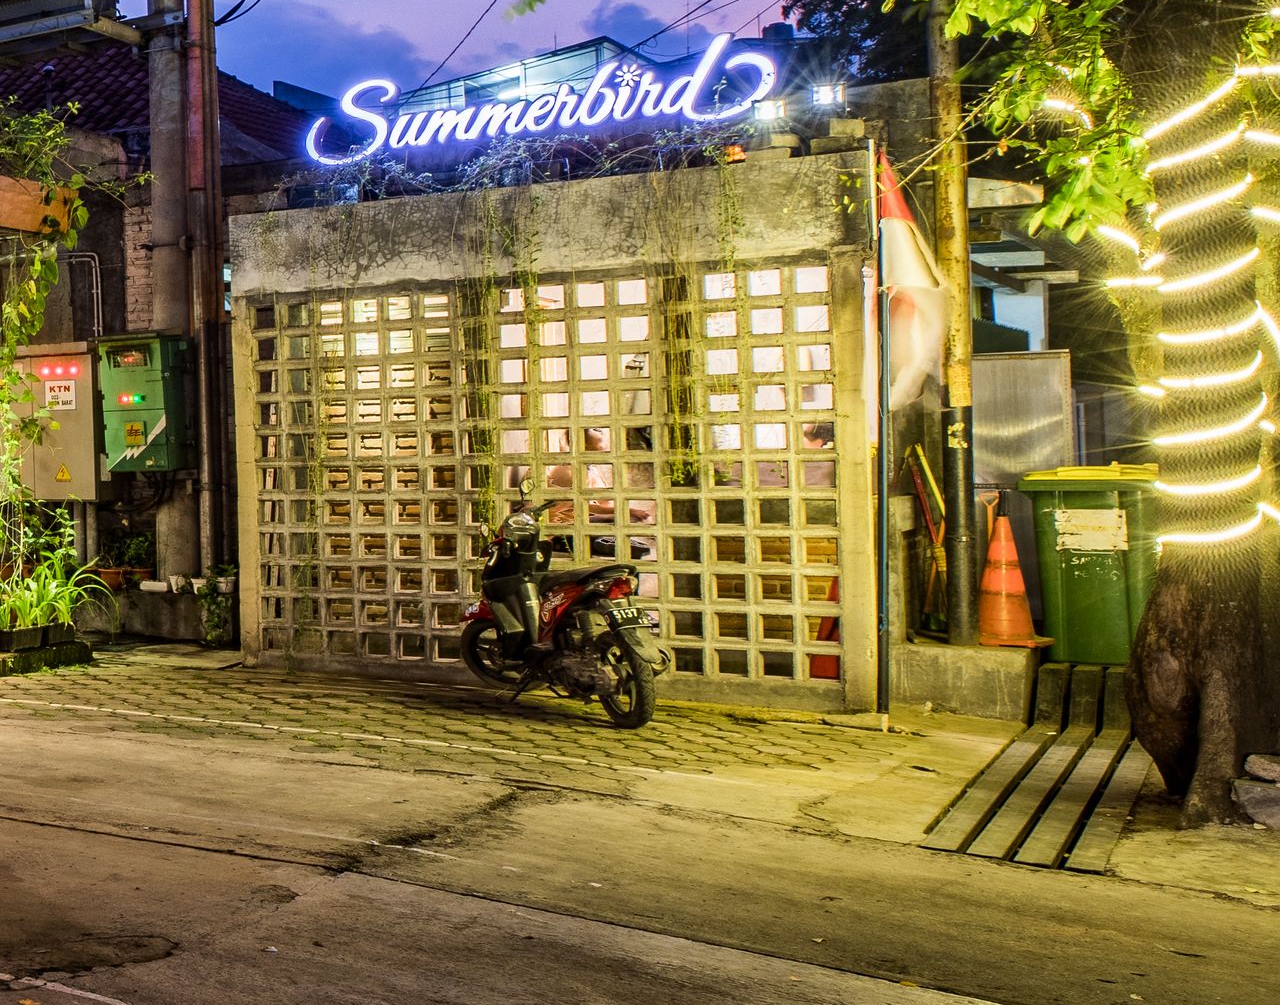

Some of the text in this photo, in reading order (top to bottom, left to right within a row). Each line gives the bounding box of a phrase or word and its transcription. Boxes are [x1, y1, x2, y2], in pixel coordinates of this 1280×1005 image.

[306, 32, 777, 165] Summerbird
[49, 385, 70, 393] KTN
[612, 608, 638, 619] 5137
